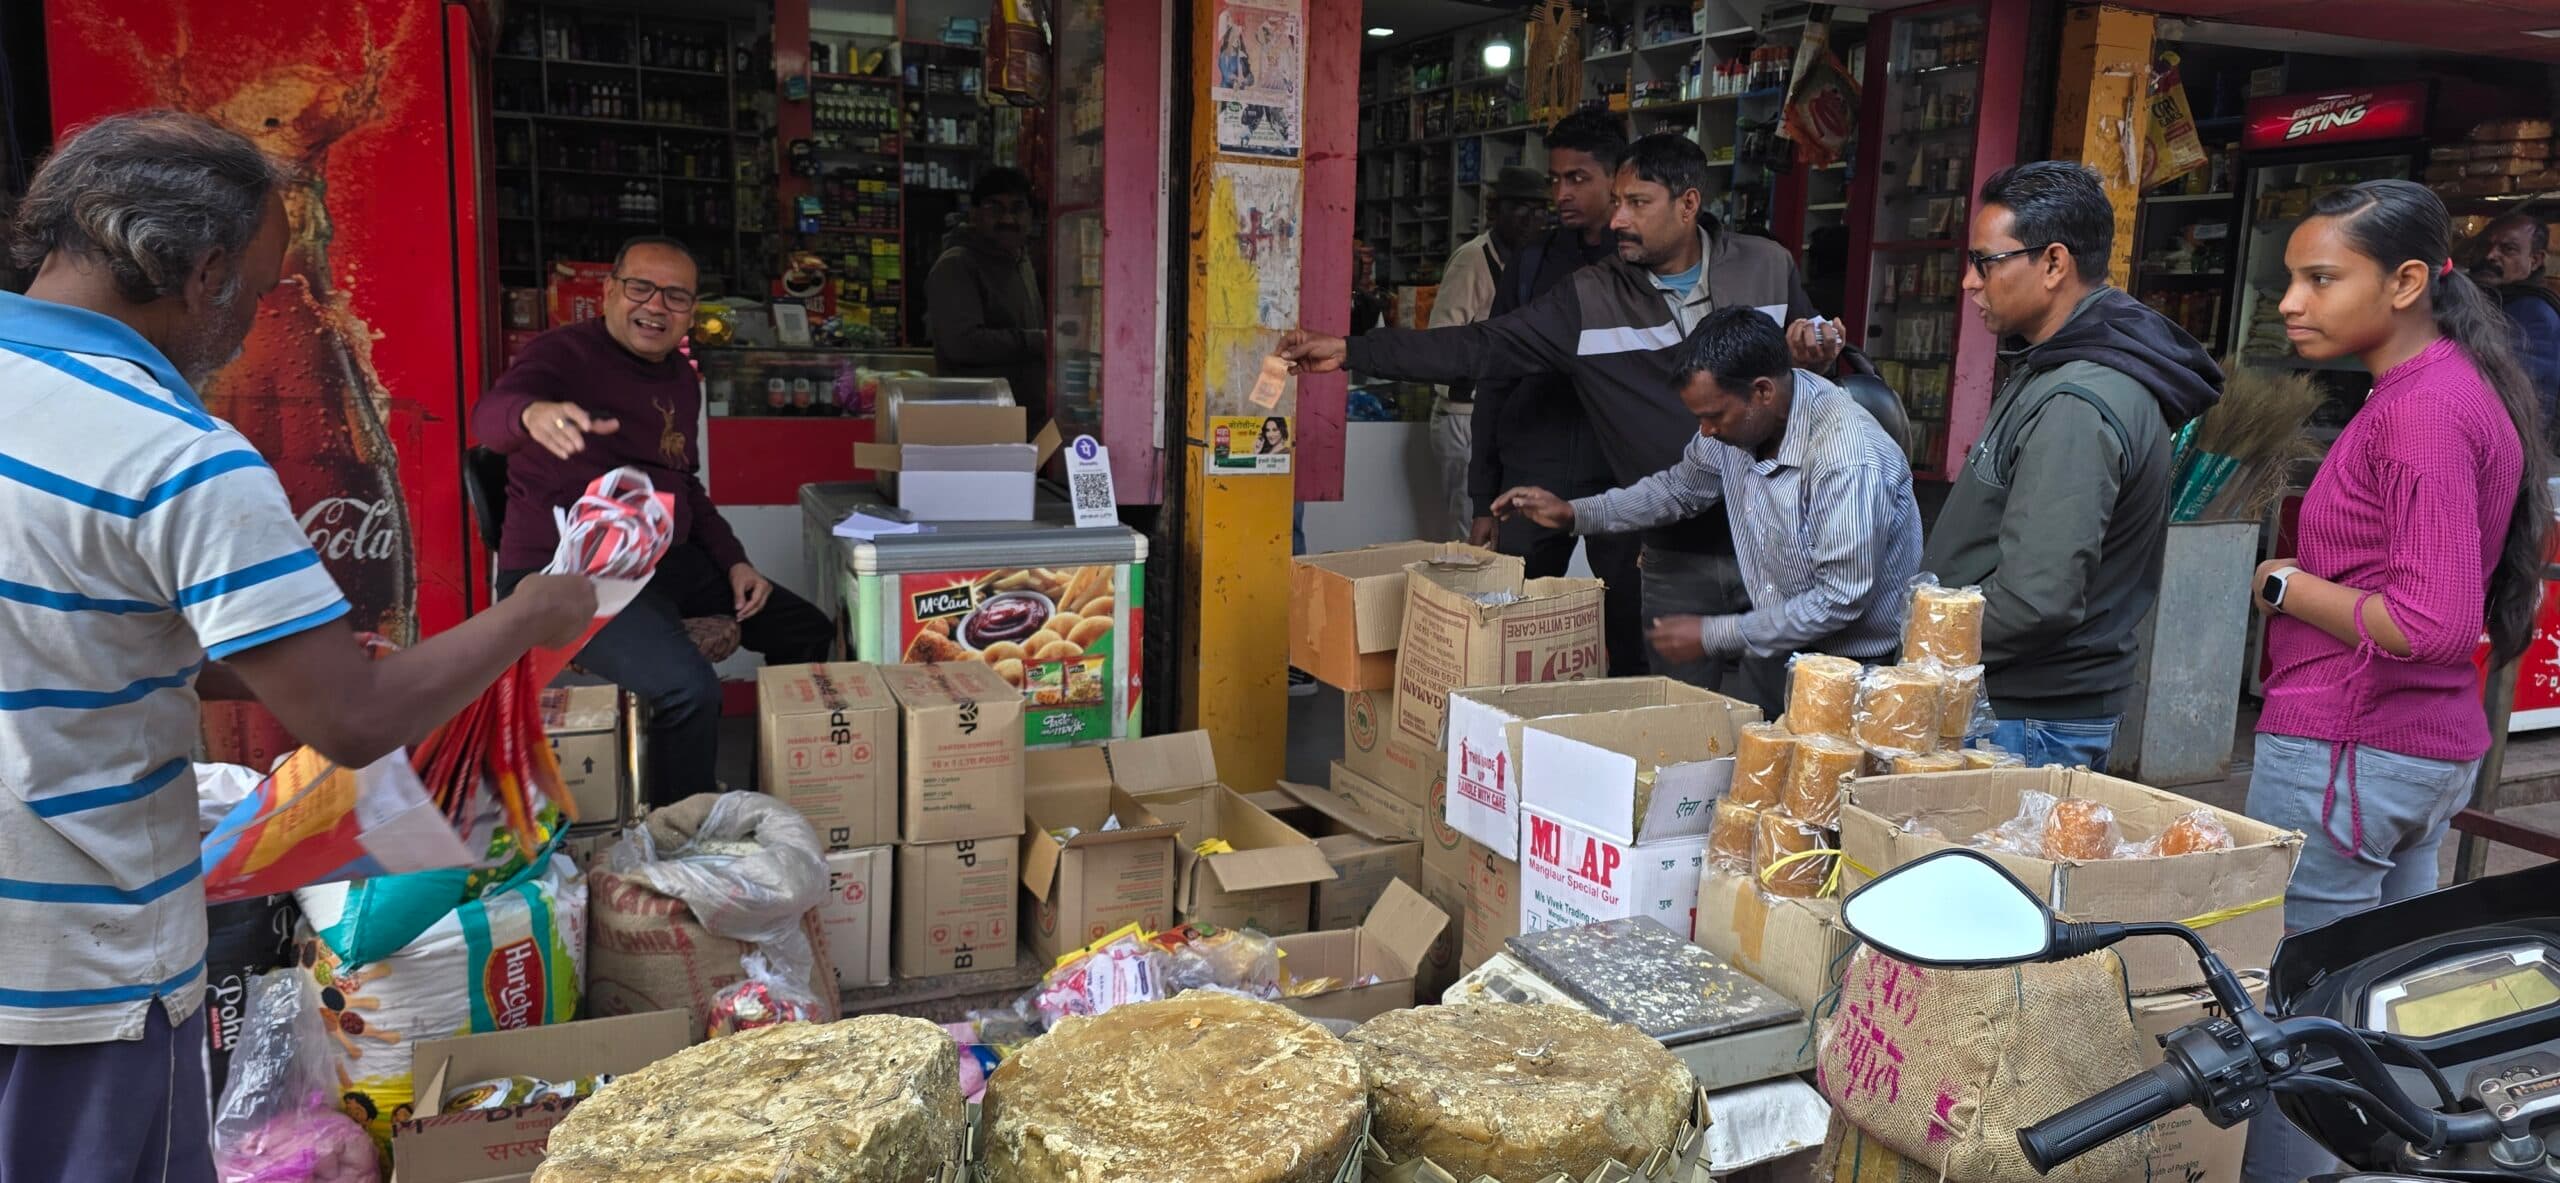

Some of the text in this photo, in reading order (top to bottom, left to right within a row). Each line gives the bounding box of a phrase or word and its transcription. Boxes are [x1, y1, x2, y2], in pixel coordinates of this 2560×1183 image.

[2285, 104, 2368, 141] STING
[2292, 100, 2337, 119] ENERGY
[918, 596, 969, 615] McCain
[1507, 609, 1600, 638] HANDLE WITH CARE
[1557, 644, 1597, 675] NET
[1676, 796, 1702, 819] ऐसा
[1530, 815, 1620, 888] MIAP
[1529, 858, 1620, 906] Manglaur Special Gur
[1547, 892, 1563, 910] Vivek
[1564, 902, 1590, 924] Trading
[500, 940, 533, 1031] Haricha
[206, 974, 244, 1051] Poha
